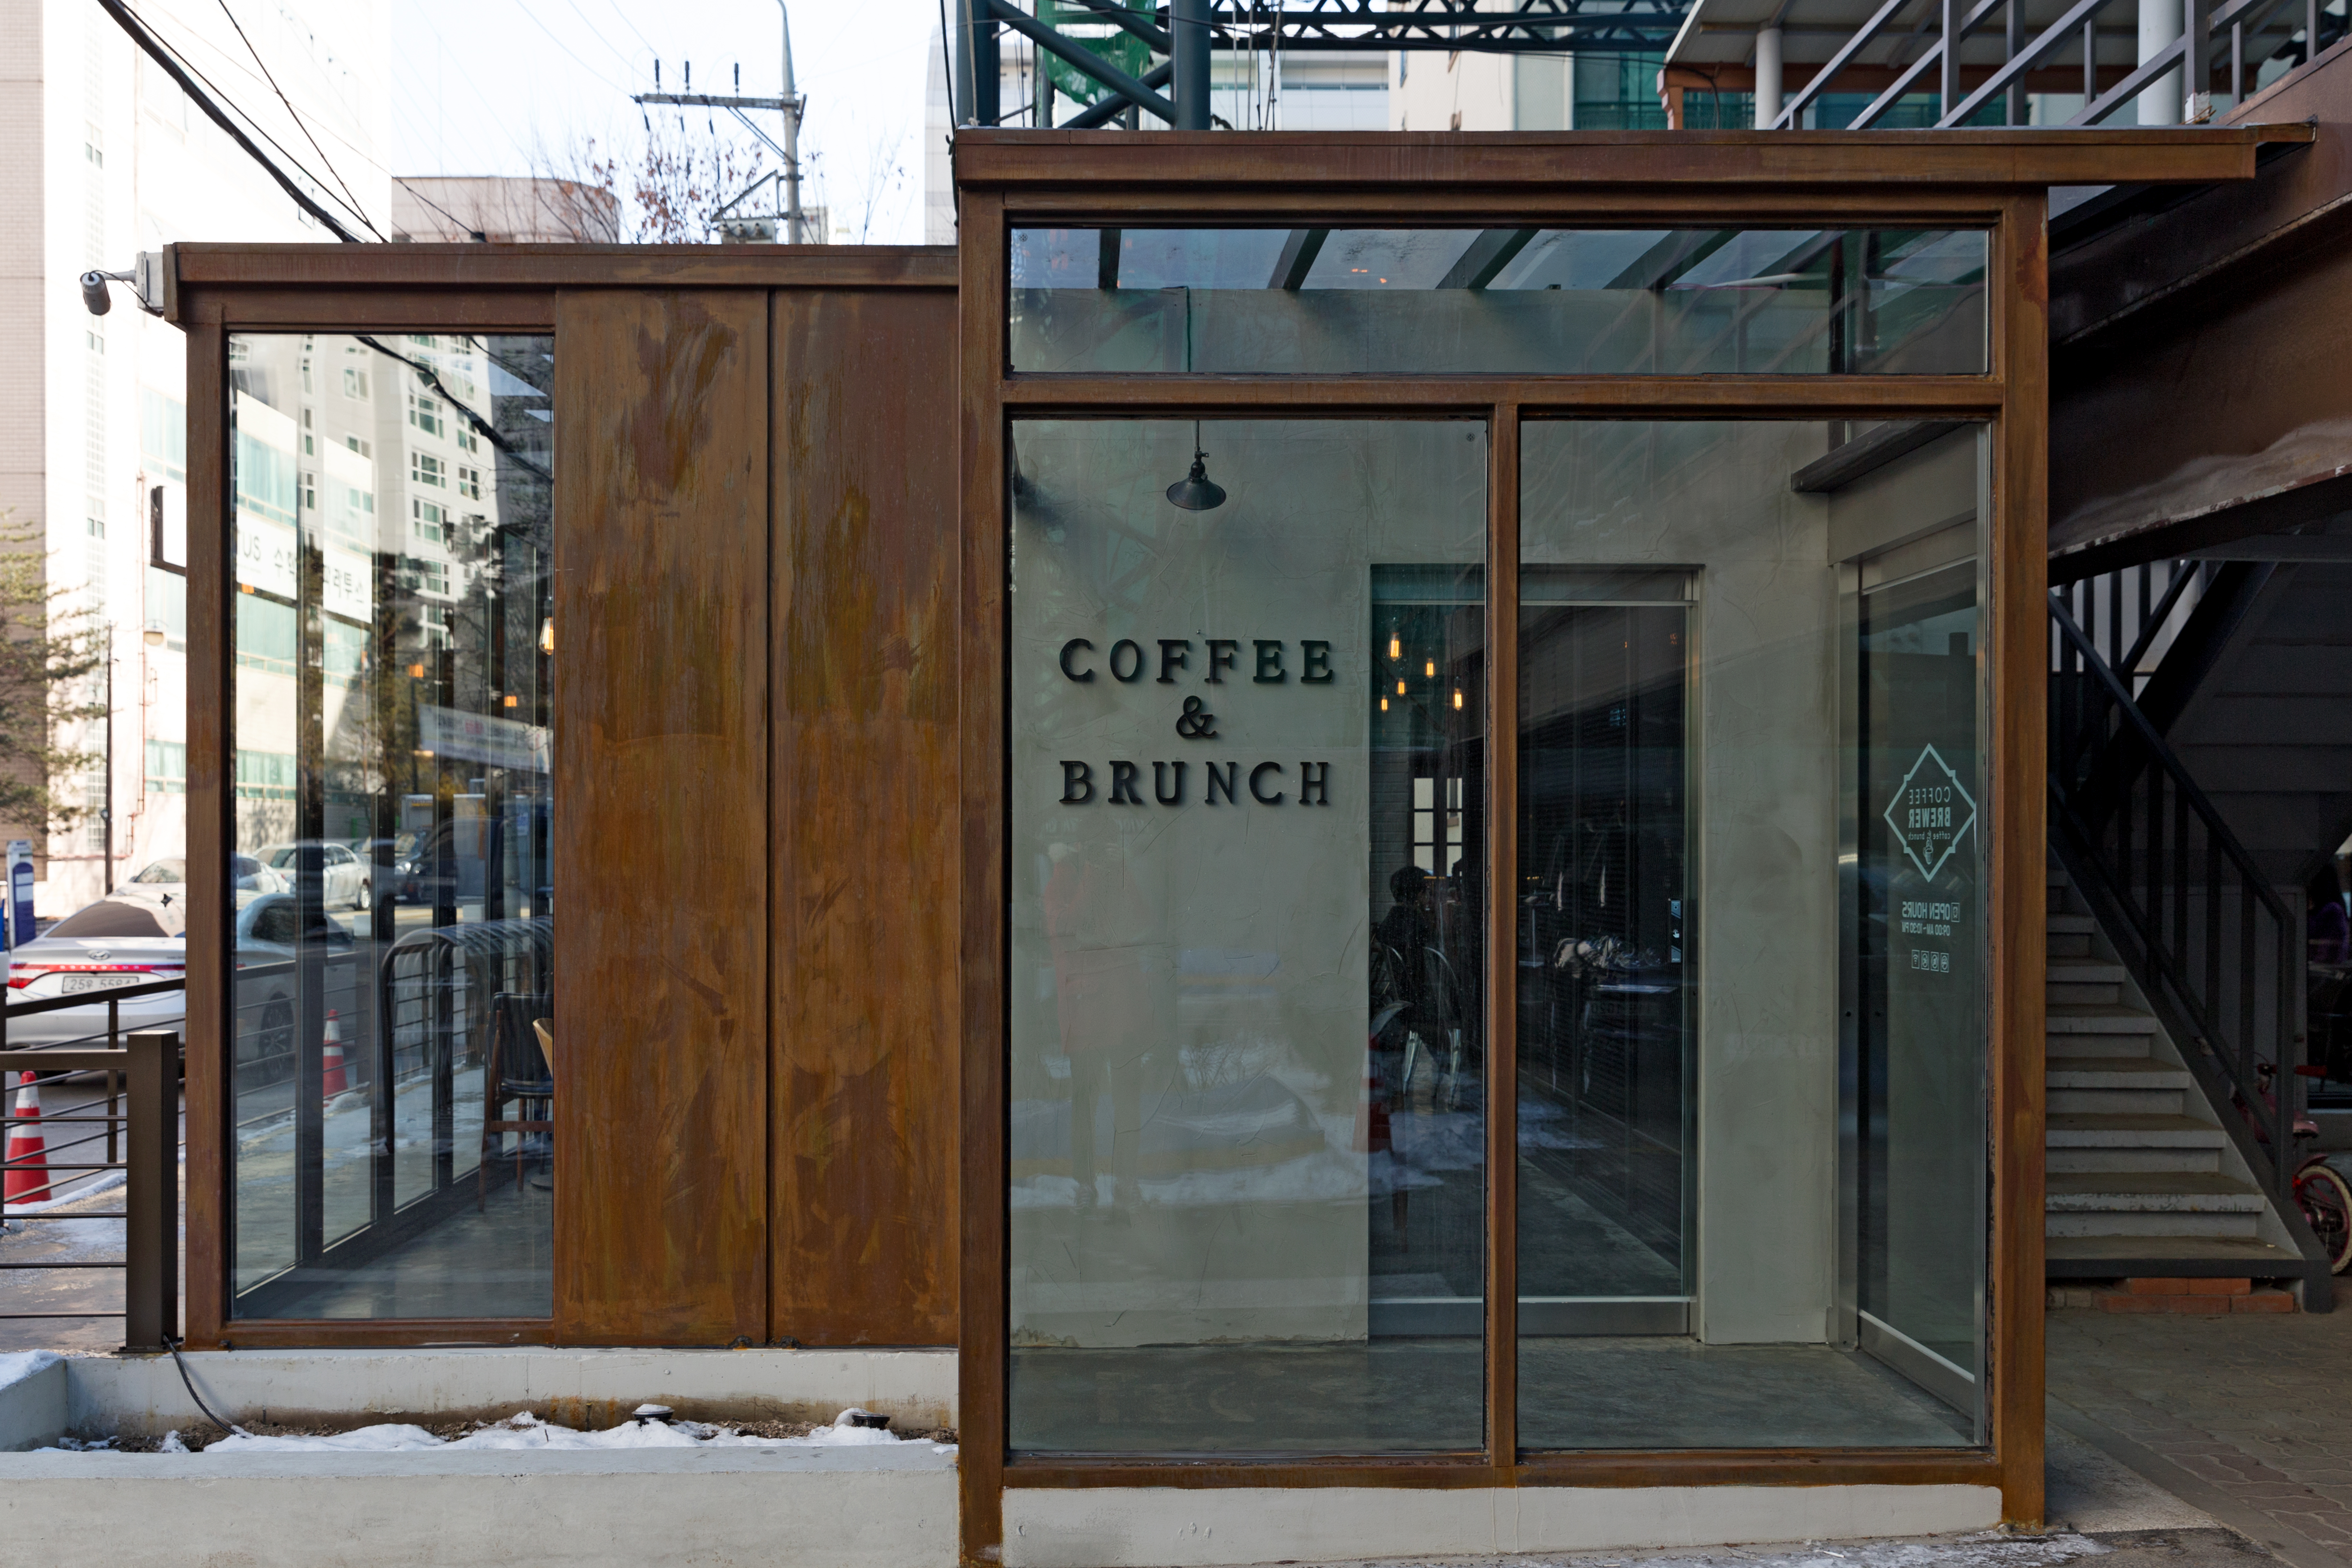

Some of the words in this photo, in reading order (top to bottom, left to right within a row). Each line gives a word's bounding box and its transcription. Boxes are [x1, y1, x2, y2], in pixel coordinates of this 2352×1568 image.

[1059, 638, 1333, 683] COFFEE
[1176, 695, 1217, 738] &
[1059, 761, 1329, 805] BRUNCH
